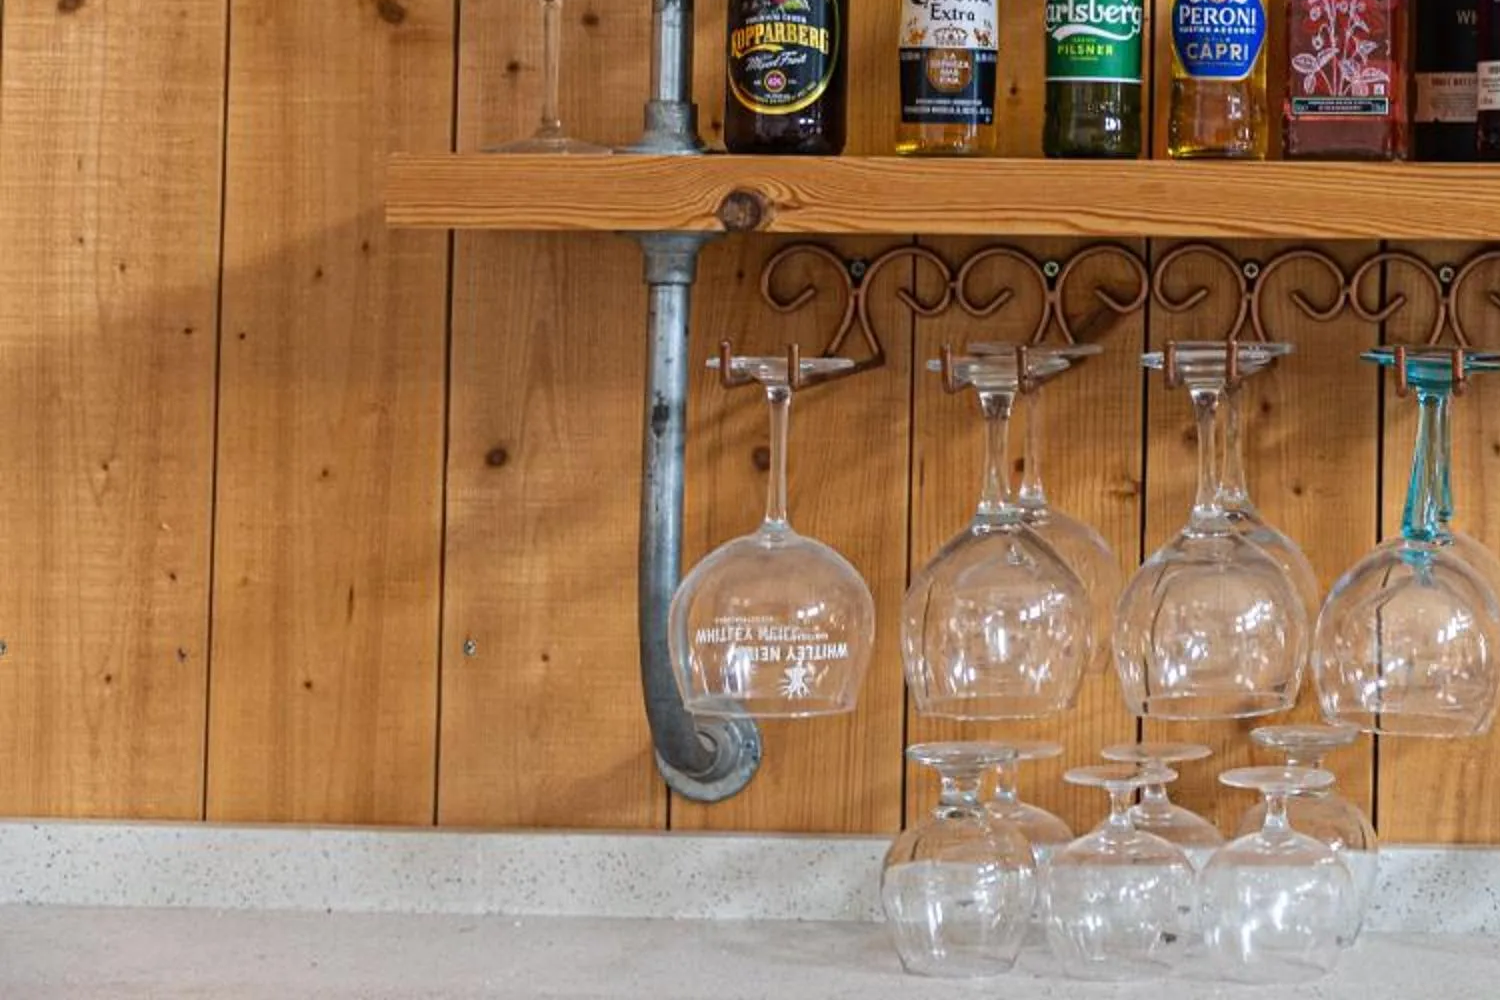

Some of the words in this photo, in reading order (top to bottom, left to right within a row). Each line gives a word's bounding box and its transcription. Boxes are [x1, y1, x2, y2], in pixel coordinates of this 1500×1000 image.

[930, 3, 976, 22] Extra
[1179, 5, 1257, 26] PERONI
[731, 21, 829, 57] KOPPARBERG
[1057, 43, 1114, 56] PILSNER
[1185, 42, 1250, 62] CAPRI
